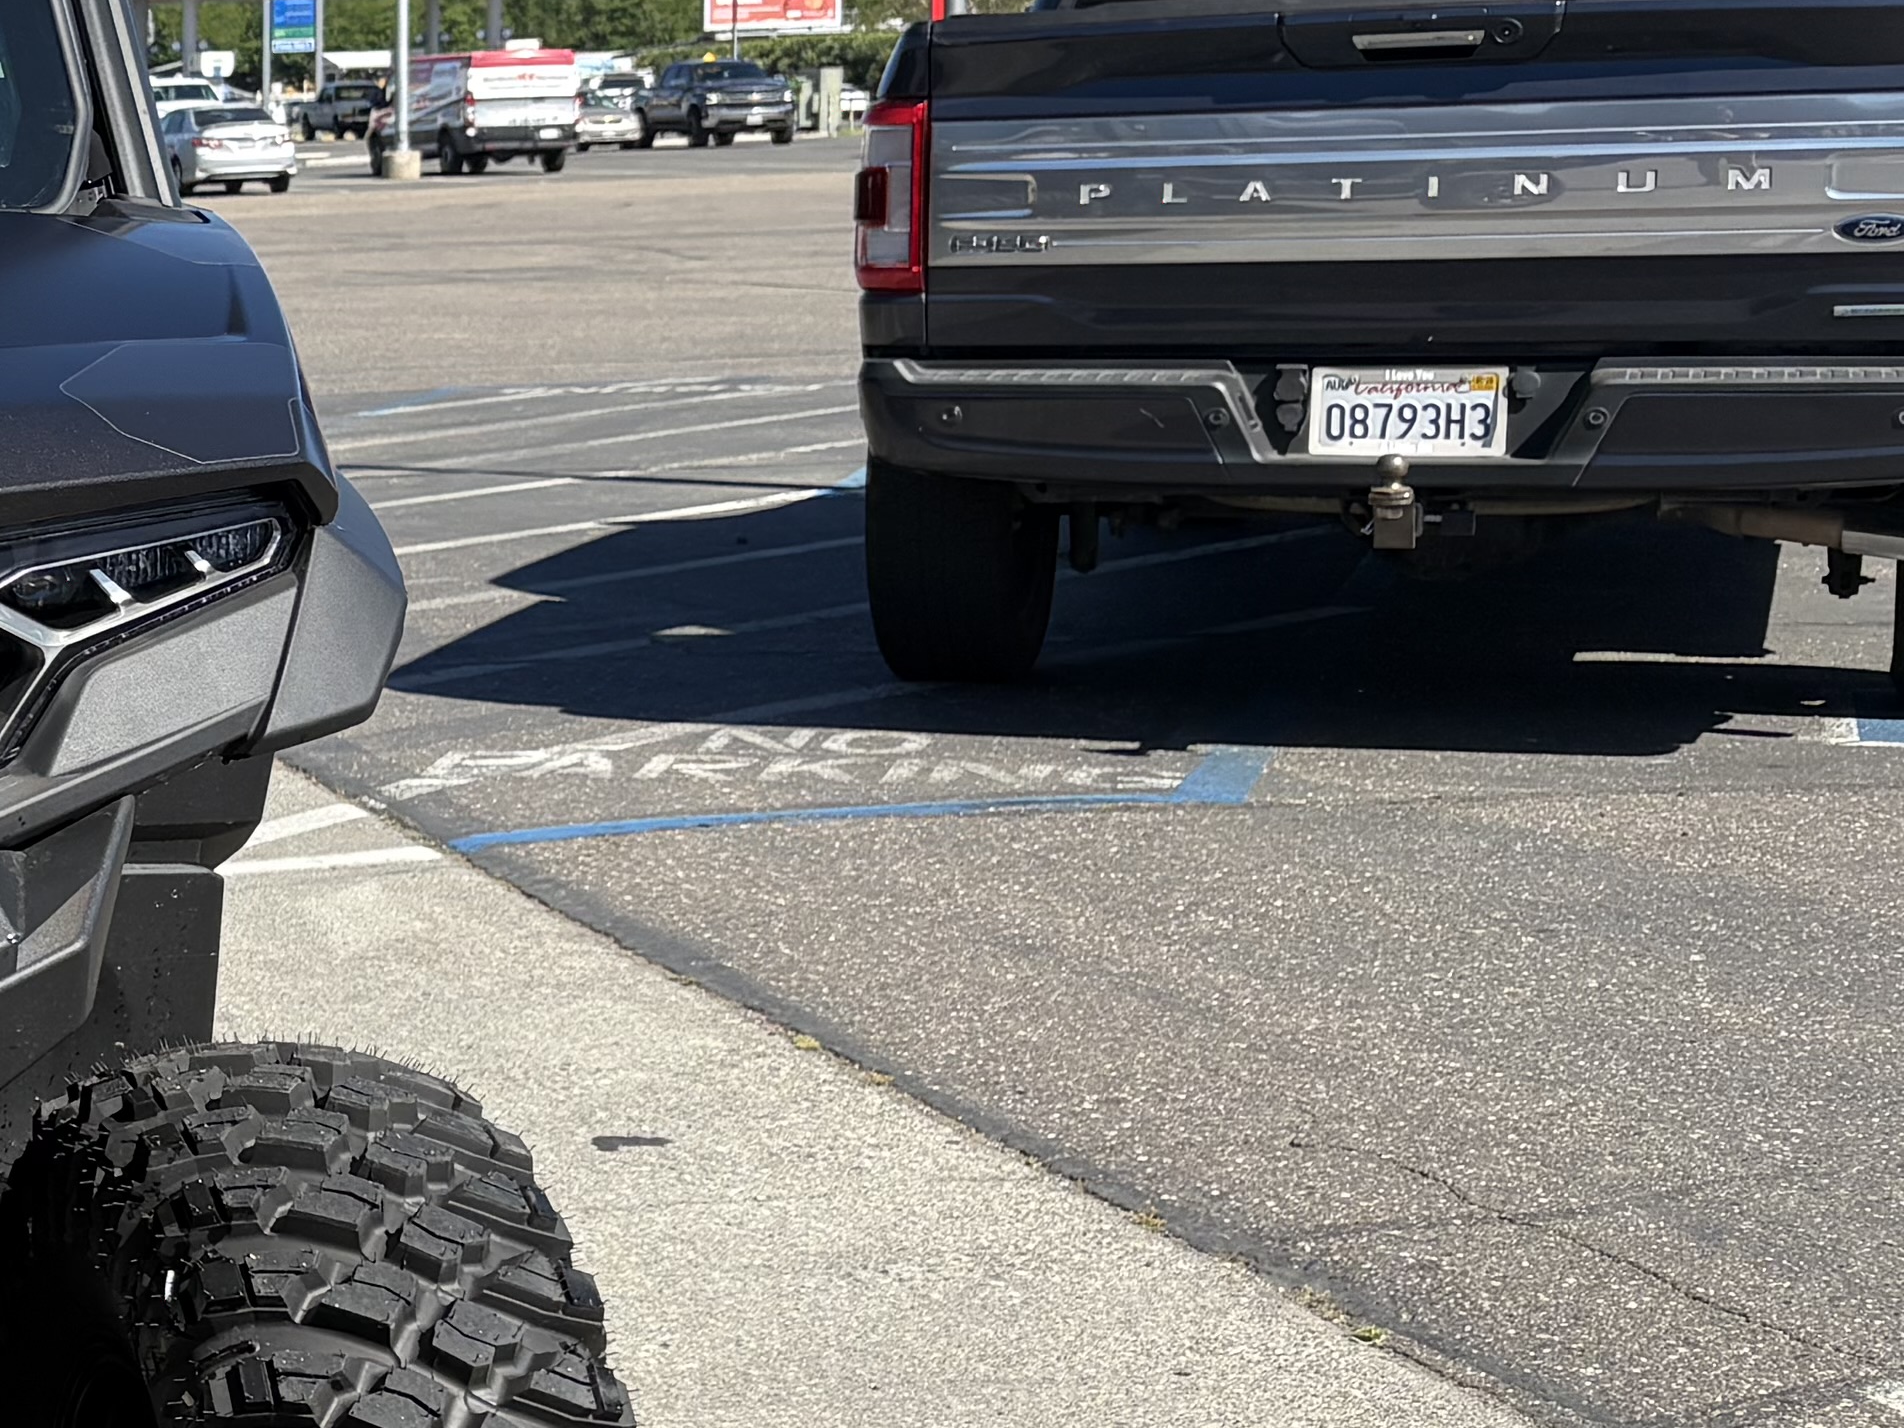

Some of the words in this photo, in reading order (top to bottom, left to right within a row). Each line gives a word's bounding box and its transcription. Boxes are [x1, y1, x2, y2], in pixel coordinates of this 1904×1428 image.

[1079, 167, 1772, 205] PLATINUM
[1854, 219, 1901, 237] Ford
[1326, 402, 1490, 441] 08793H3
[697, 727, 934, 755] NO
